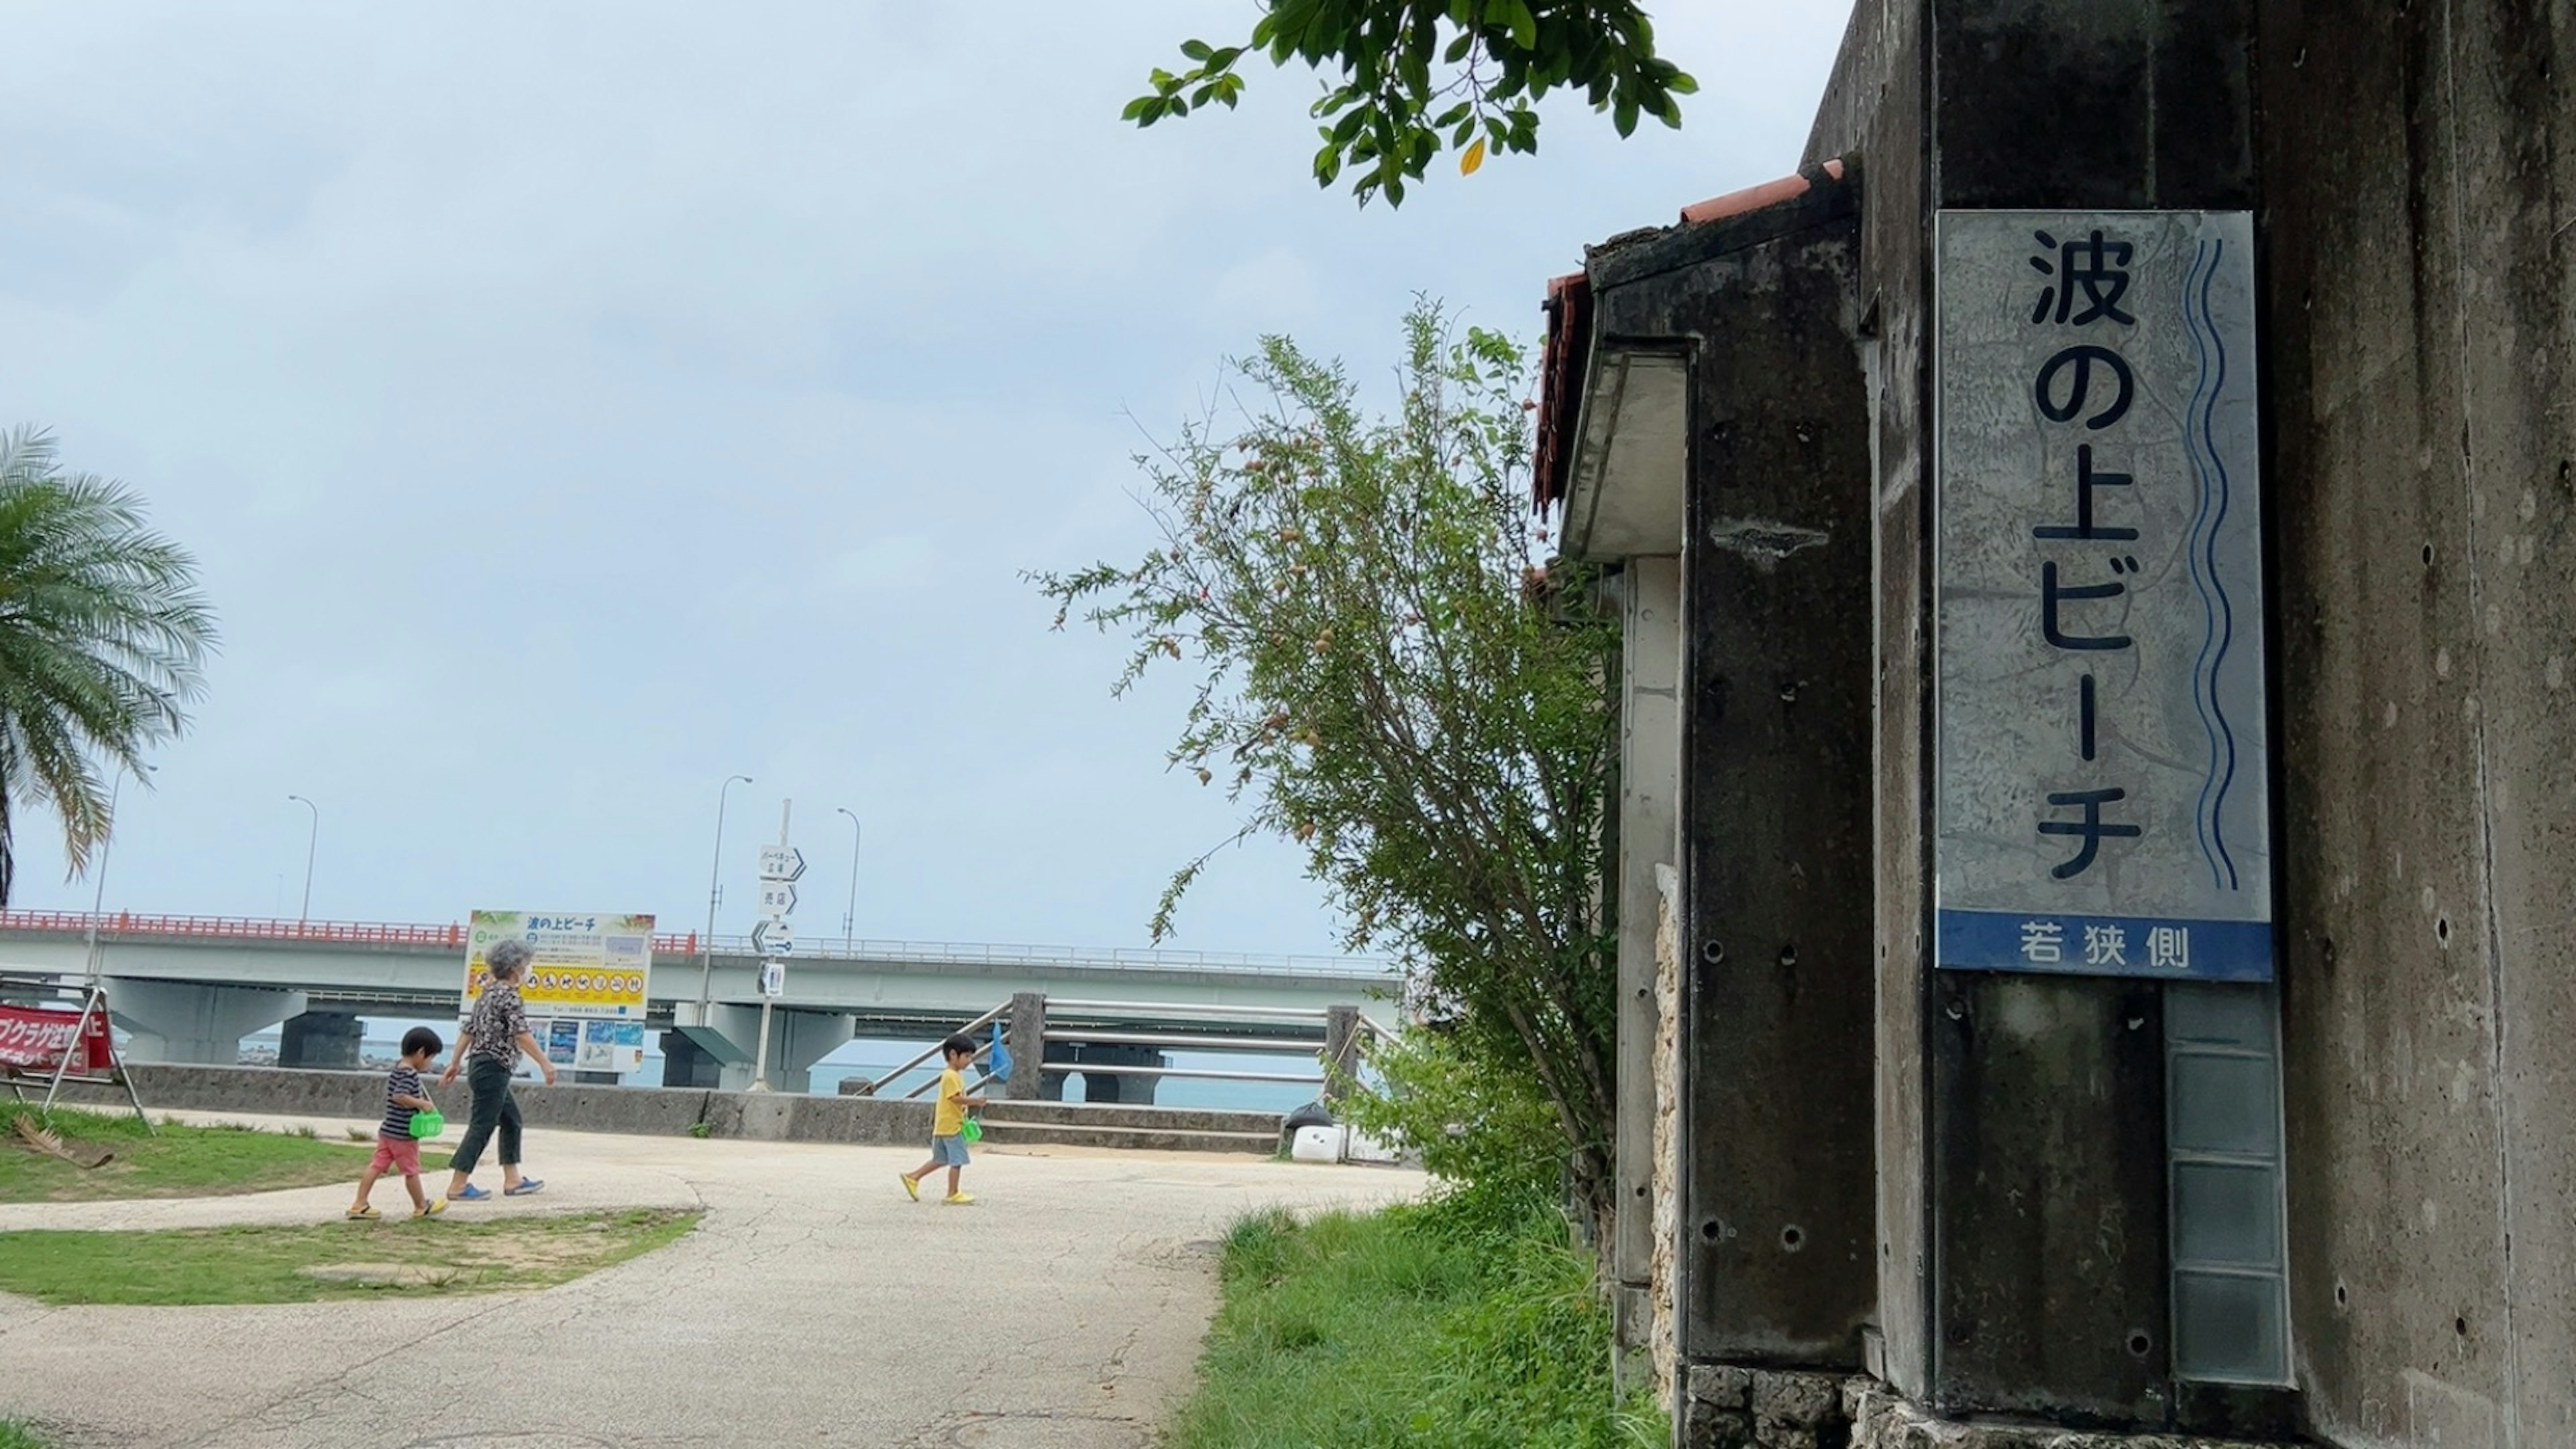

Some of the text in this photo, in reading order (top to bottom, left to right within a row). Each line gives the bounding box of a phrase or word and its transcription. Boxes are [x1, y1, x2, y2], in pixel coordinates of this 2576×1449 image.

[2029, 229, 2143, 879] 波の上ビーチ
[527, 916, 595, 931] 波の上ビーチ
[2021, 920, 2190, 969] 若狭側
